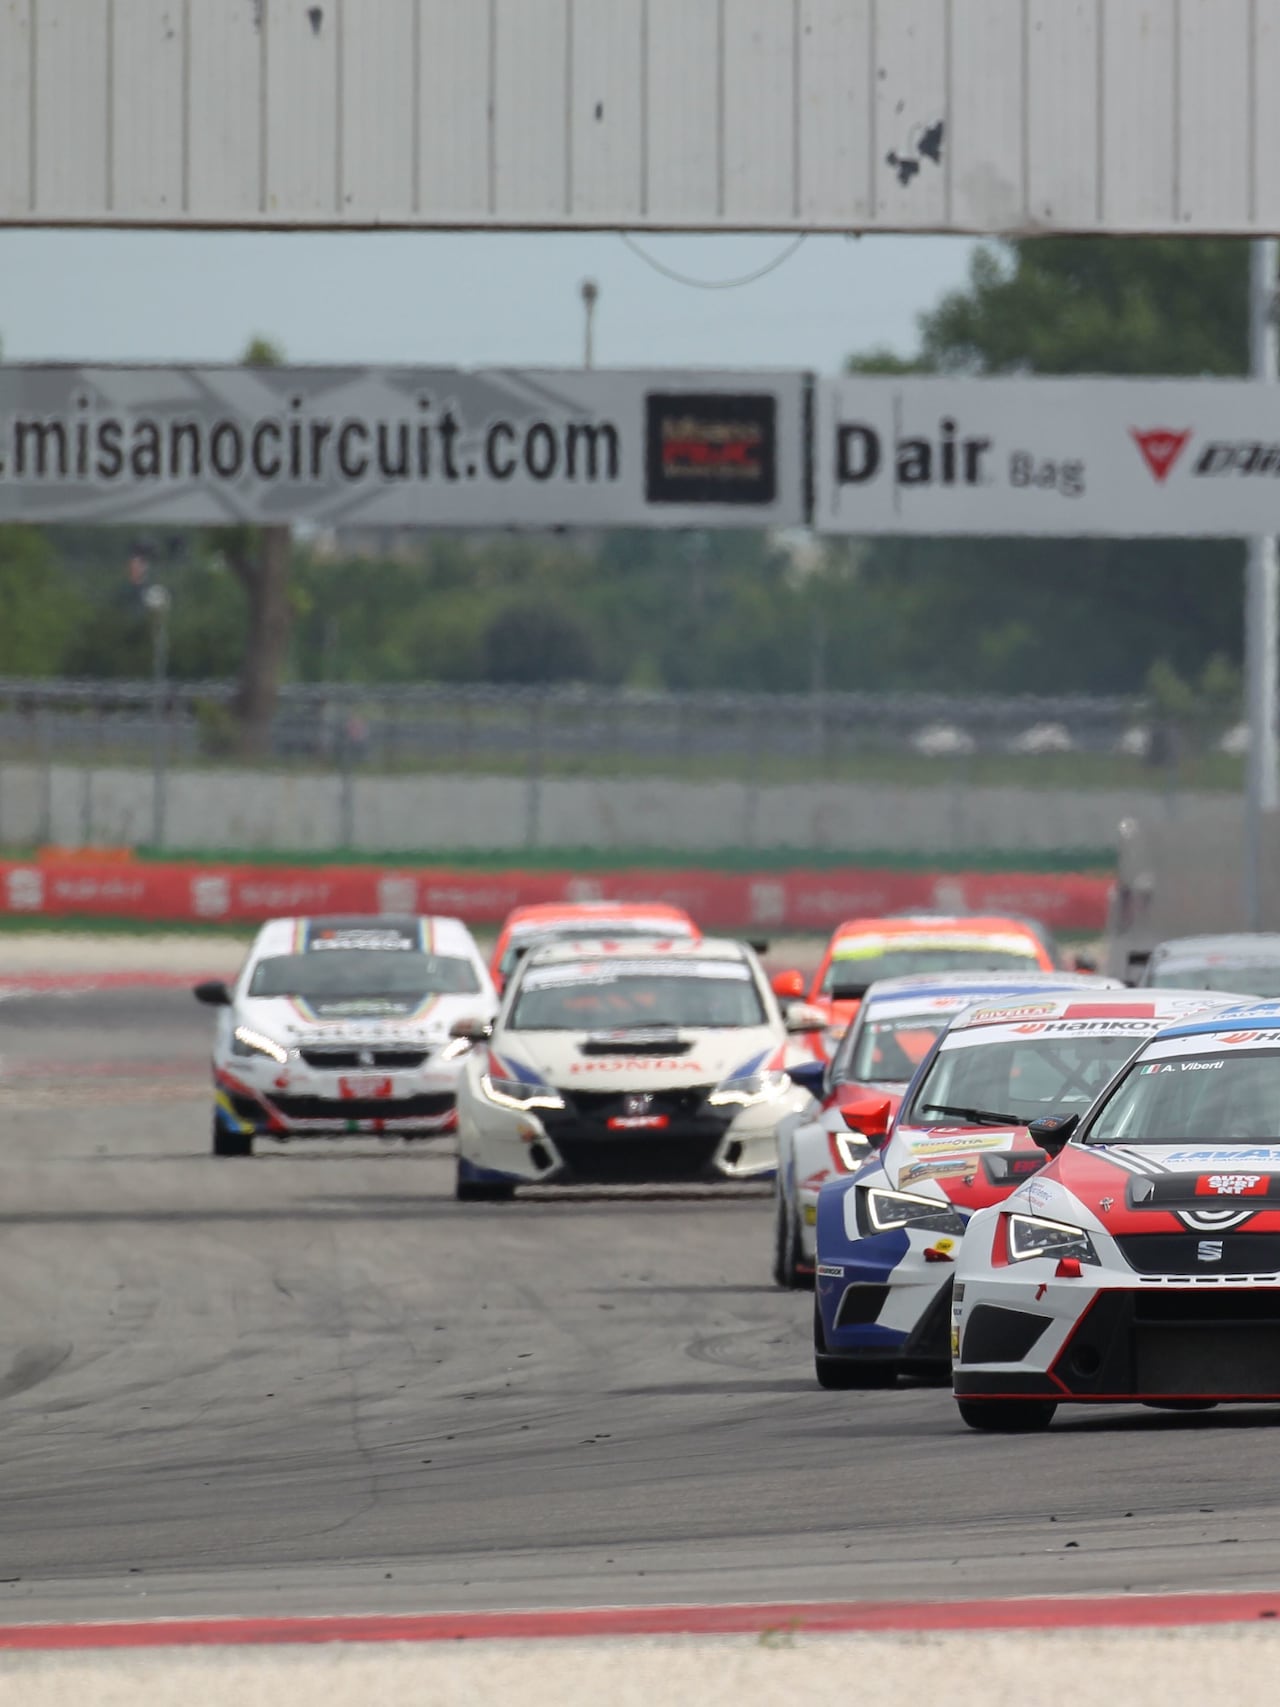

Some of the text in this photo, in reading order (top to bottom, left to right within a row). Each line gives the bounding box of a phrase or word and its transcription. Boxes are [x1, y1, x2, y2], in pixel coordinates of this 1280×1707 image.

[1010, 450, 1086, 498] Bag
[1160, 1060, 1225, 1074] A. Viberti
